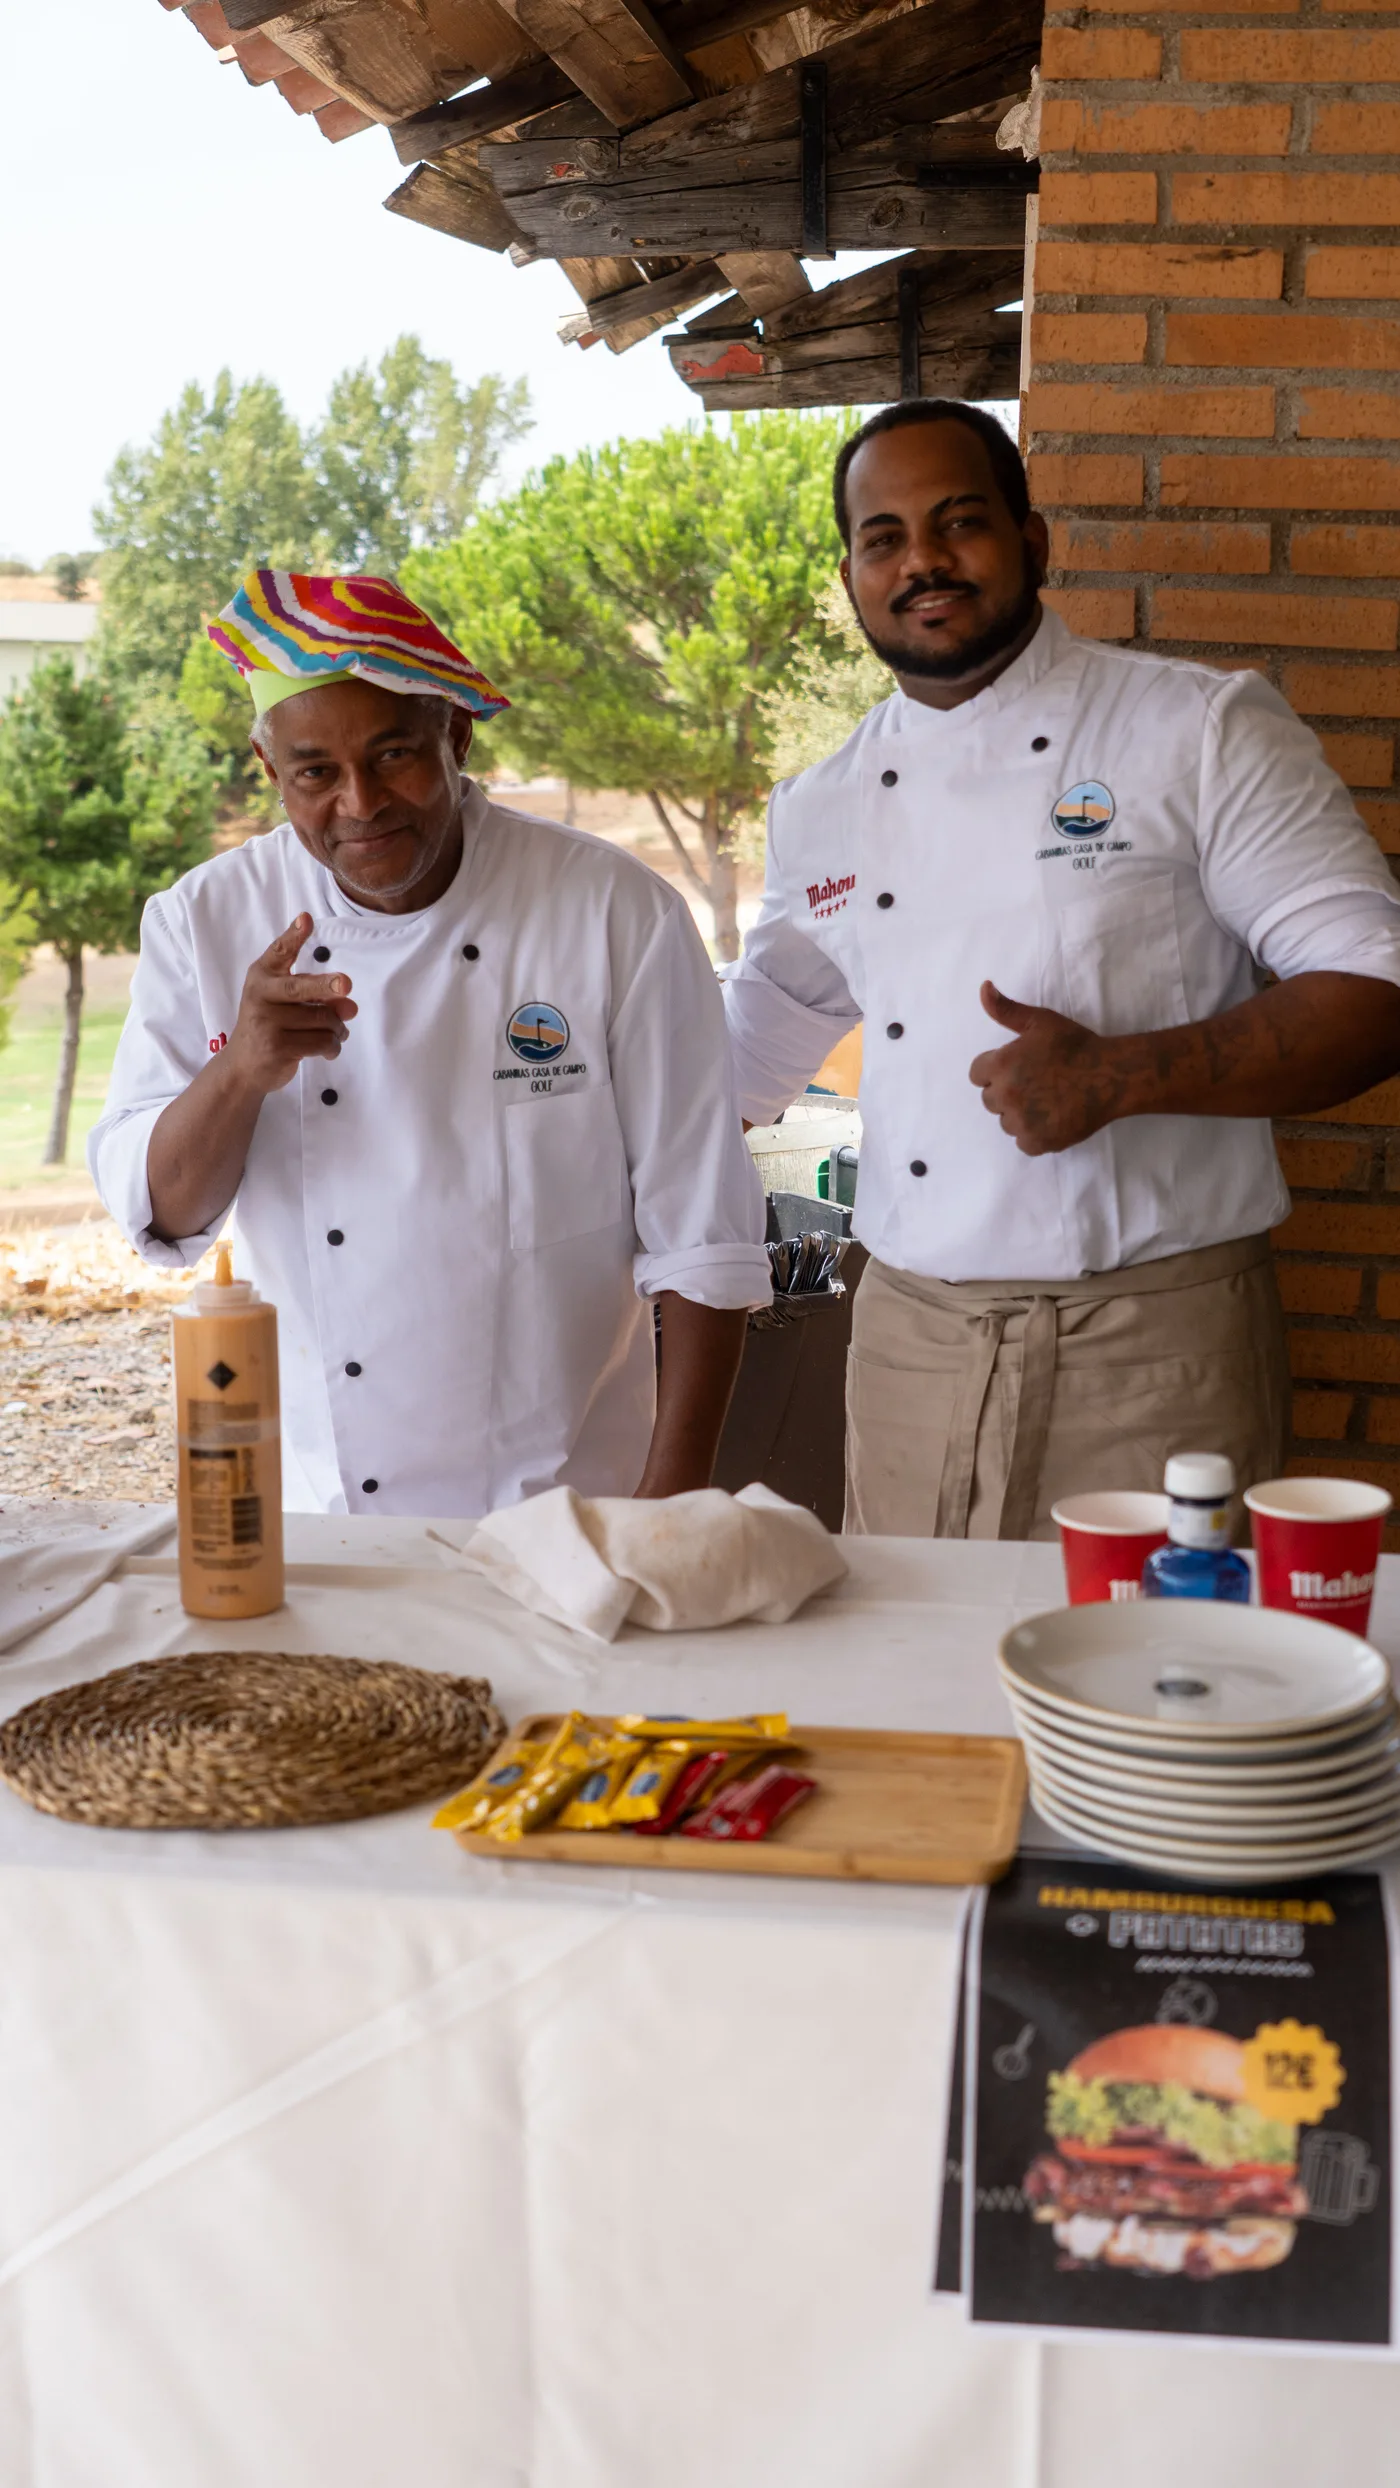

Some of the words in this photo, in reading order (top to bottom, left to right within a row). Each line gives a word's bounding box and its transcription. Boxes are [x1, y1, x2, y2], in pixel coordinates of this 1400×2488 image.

[1074, 843, 1093, 854] CASA
[1095, 842, 1105, 853] DE
[1107, 841, 1132, 852] CAMPO
[1072, 856, 1097, 871] GOLF
[806, 874, 856, 909] Mahou
[532, 1067, 551, 1078] CASA
[552, 1065, 561, 1076] DE
[563, 1064, 586, 1075] CAMPO
[531, 1079, 553, 1094] GOLF
[1038, 1885, 1337, 1926] HAMBURGUESA
[1107, 1909, 1305, 1957] PATATAS
